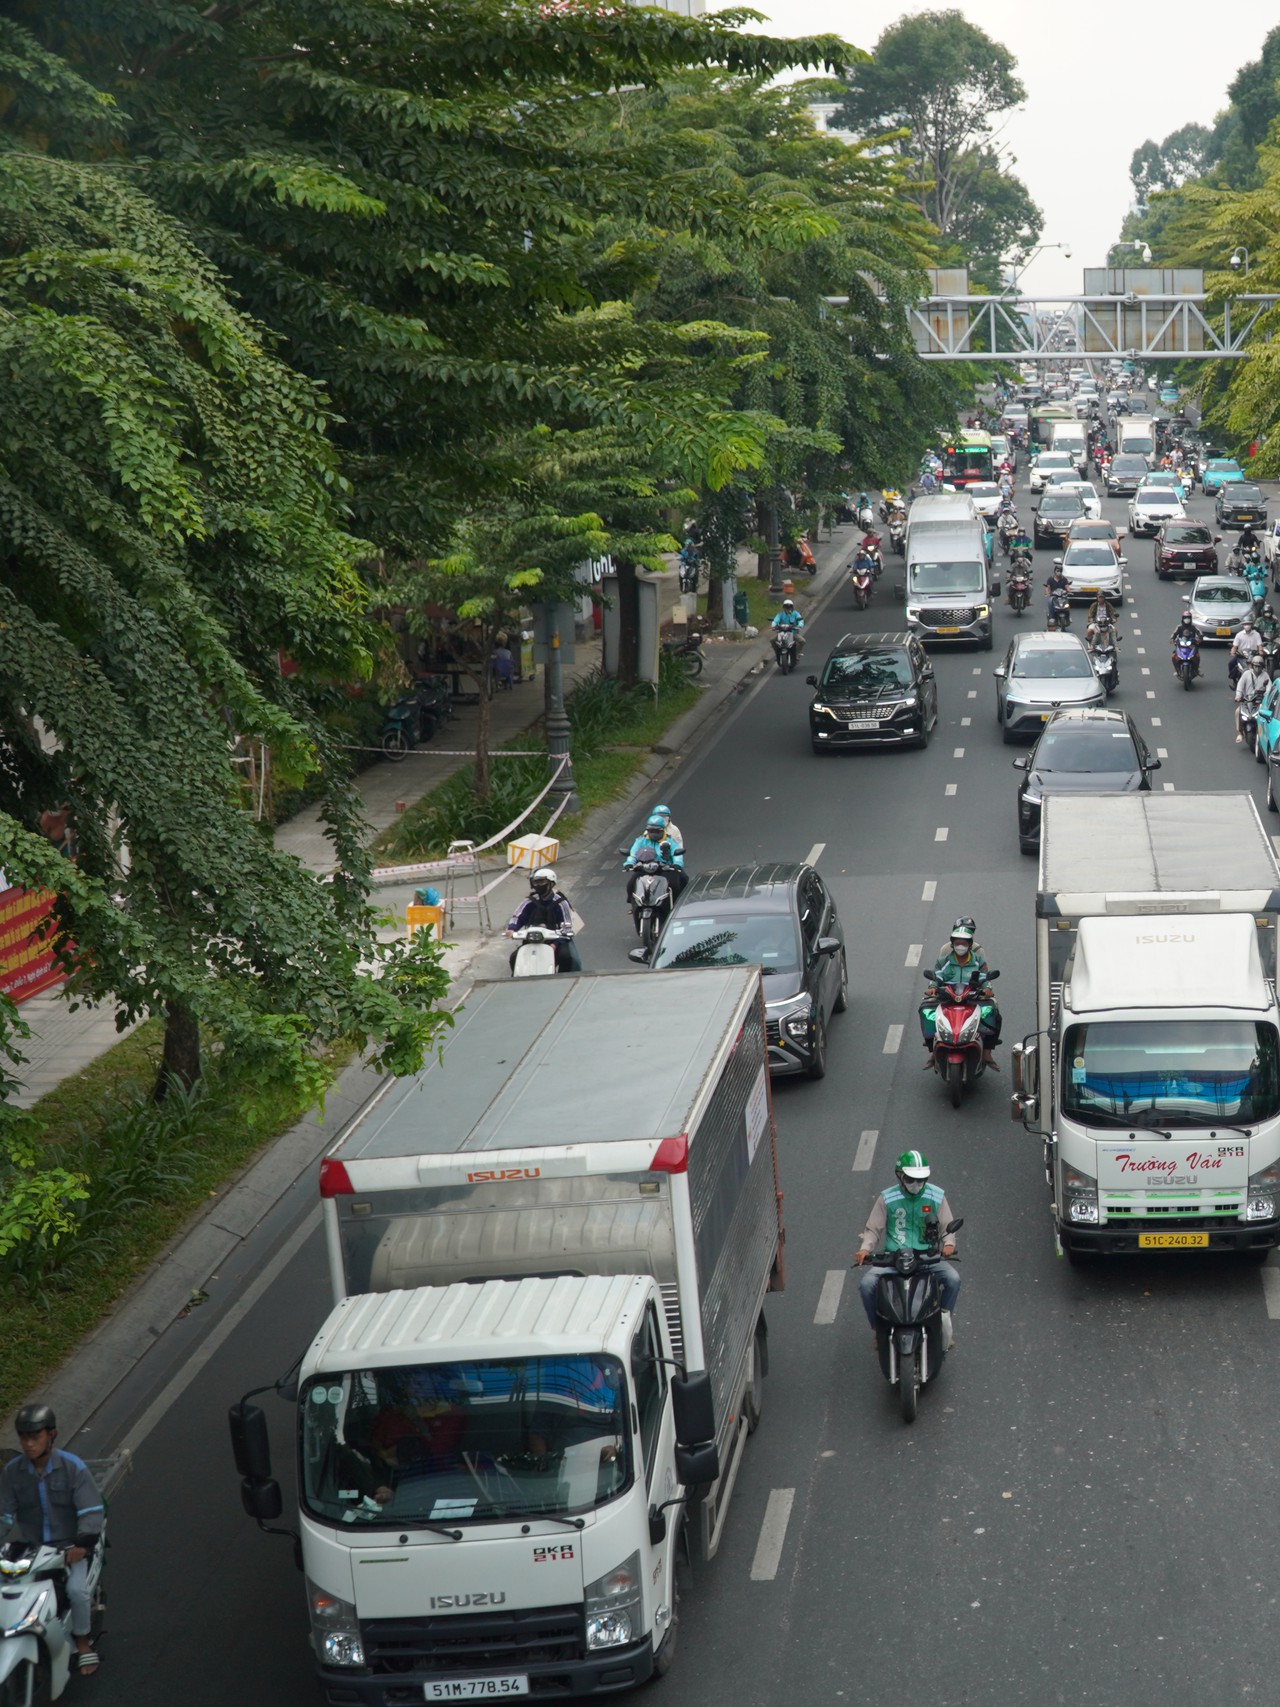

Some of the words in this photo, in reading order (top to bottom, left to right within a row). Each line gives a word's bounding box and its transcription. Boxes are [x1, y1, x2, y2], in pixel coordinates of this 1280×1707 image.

[1138, 904, 1188, 912] ISUZU
[1136, 934, 1195, 944] ISUZU
[1115, 1154, 1178, 1176] Trường
[1186, 1152, 1223, 1170] Vân
[467, 1168, 540, 1183] ISUZU
[1146, 1175, 1198, 1186] ISUZU
[1144, 1236, 1203, 1246] 51C-240.32
[533, 1544, 573, 1555] QKR
[534, 1552, 574, 1562] 210
[430, 1591, 506, 1609] ISUZU
[432, 1678, 520, 1698] 51M-778.54
